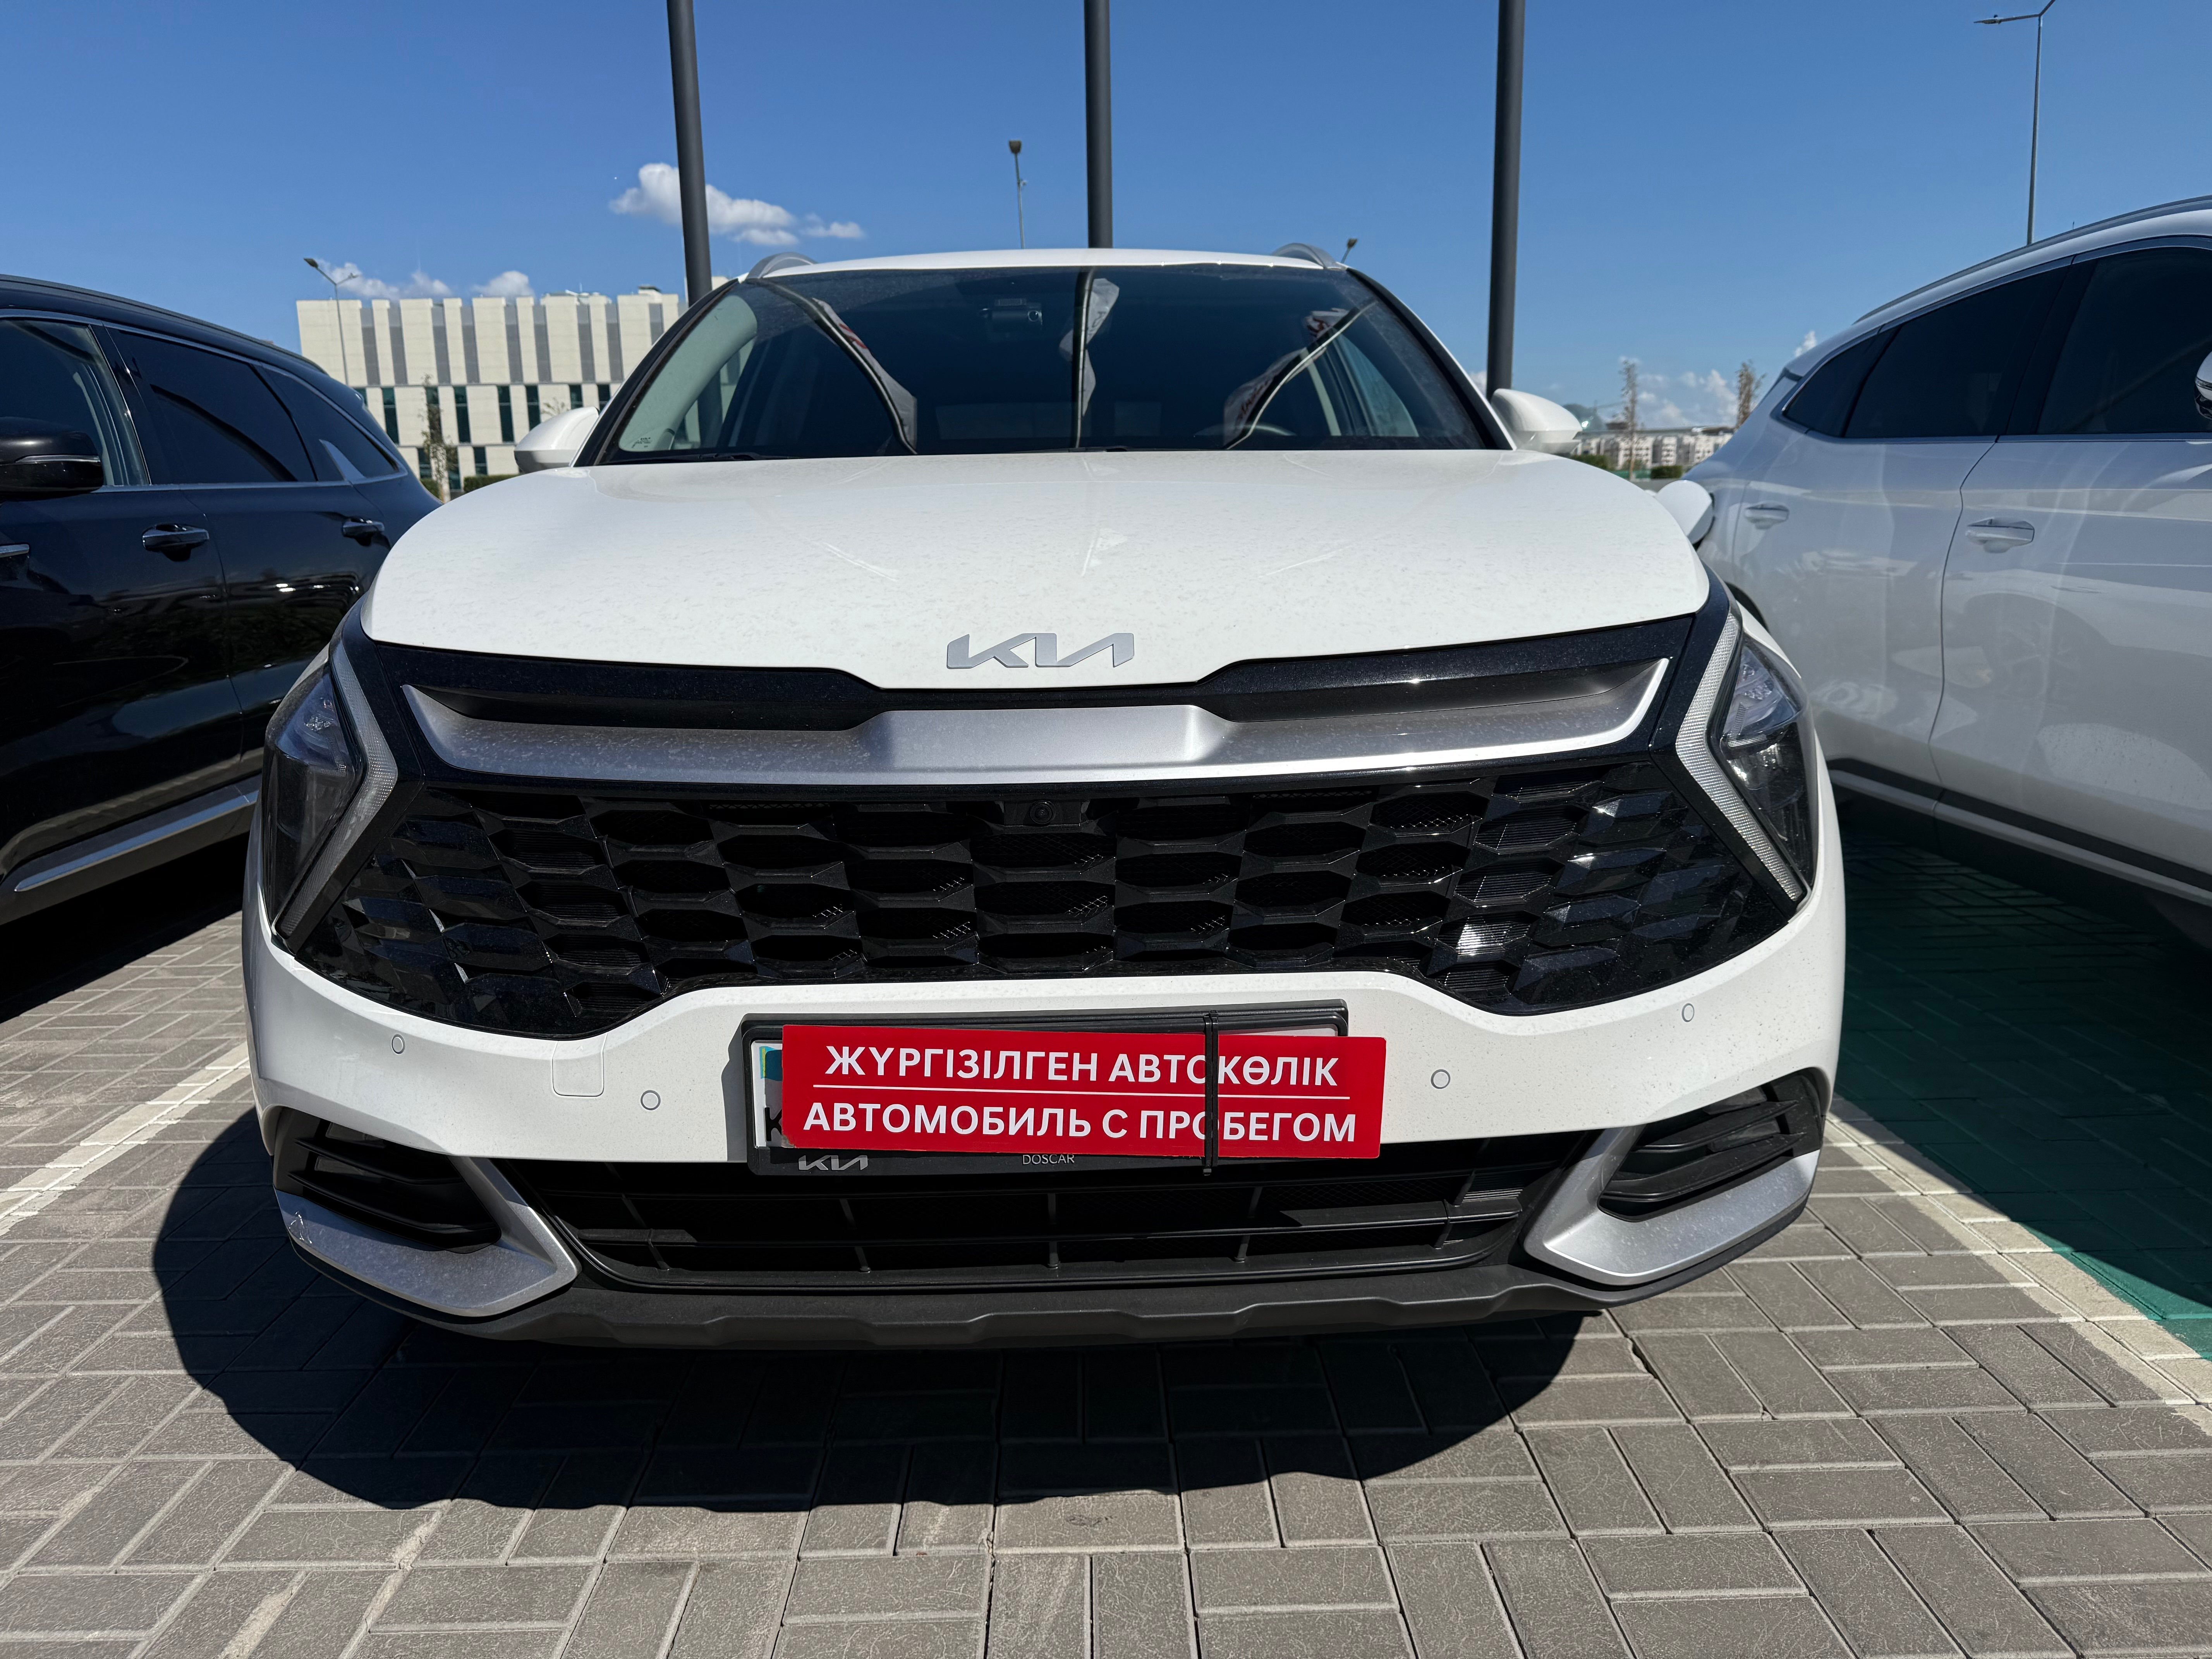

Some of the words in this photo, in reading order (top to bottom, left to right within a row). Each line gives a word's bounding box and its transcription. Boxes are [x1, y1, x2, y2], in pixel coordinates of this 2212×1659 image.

[947, 632, 1134, 669] KIA
[825, 1045, 1098, 1082] ЖҮРГІЗІЛГЕН
[1108, 1053, 1339, 1086] АВТОКӨЛІК
[803, 1102, 1091, 1137] АВТОМОБИЛЬ
[1102, 1109, 1128, 1139] С
[798, 1155, 868, 1171] KIA
[1022, 1154, 1075, 1165] DOSCAR
